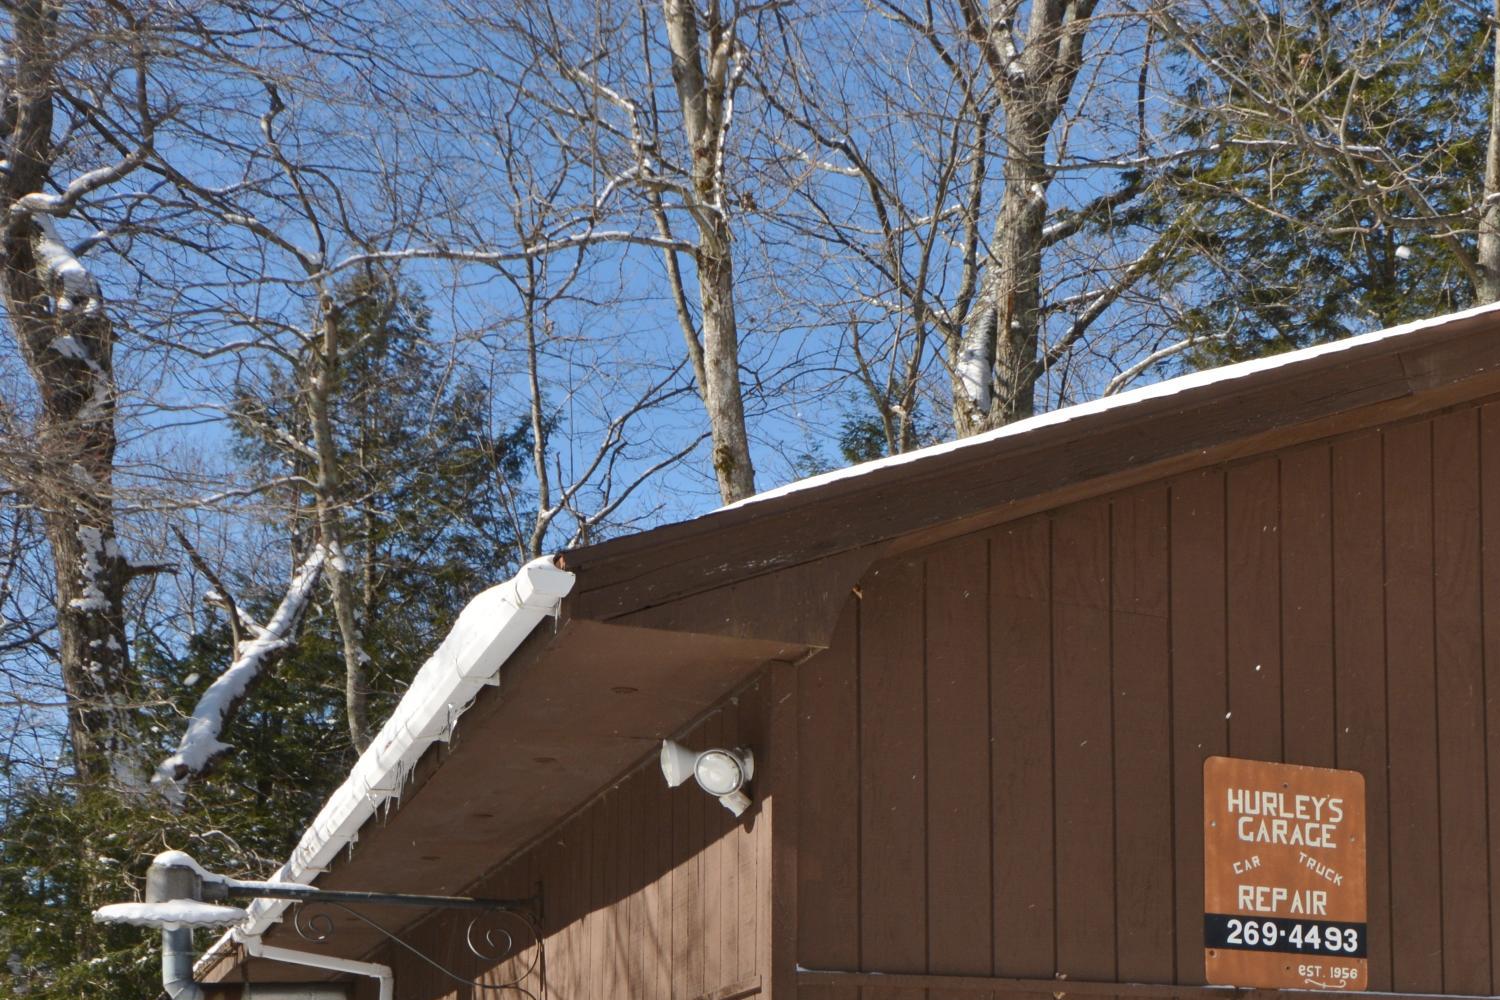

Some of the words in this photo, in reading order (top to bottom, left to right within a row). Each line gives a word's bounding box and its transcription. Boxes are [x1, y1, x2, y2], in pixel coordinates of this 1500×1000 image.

[1227, 788, 1343, 823] HURLEY'S
[1238, 816, 1337, 848] GARAGE
[1232, 855, 1261, 875] CAR
[1299, 852, 1343, 886] TRUCK
[1238, 884, 1327, 915] REPAIR
[1330, 967, 1358, 979] 1956
